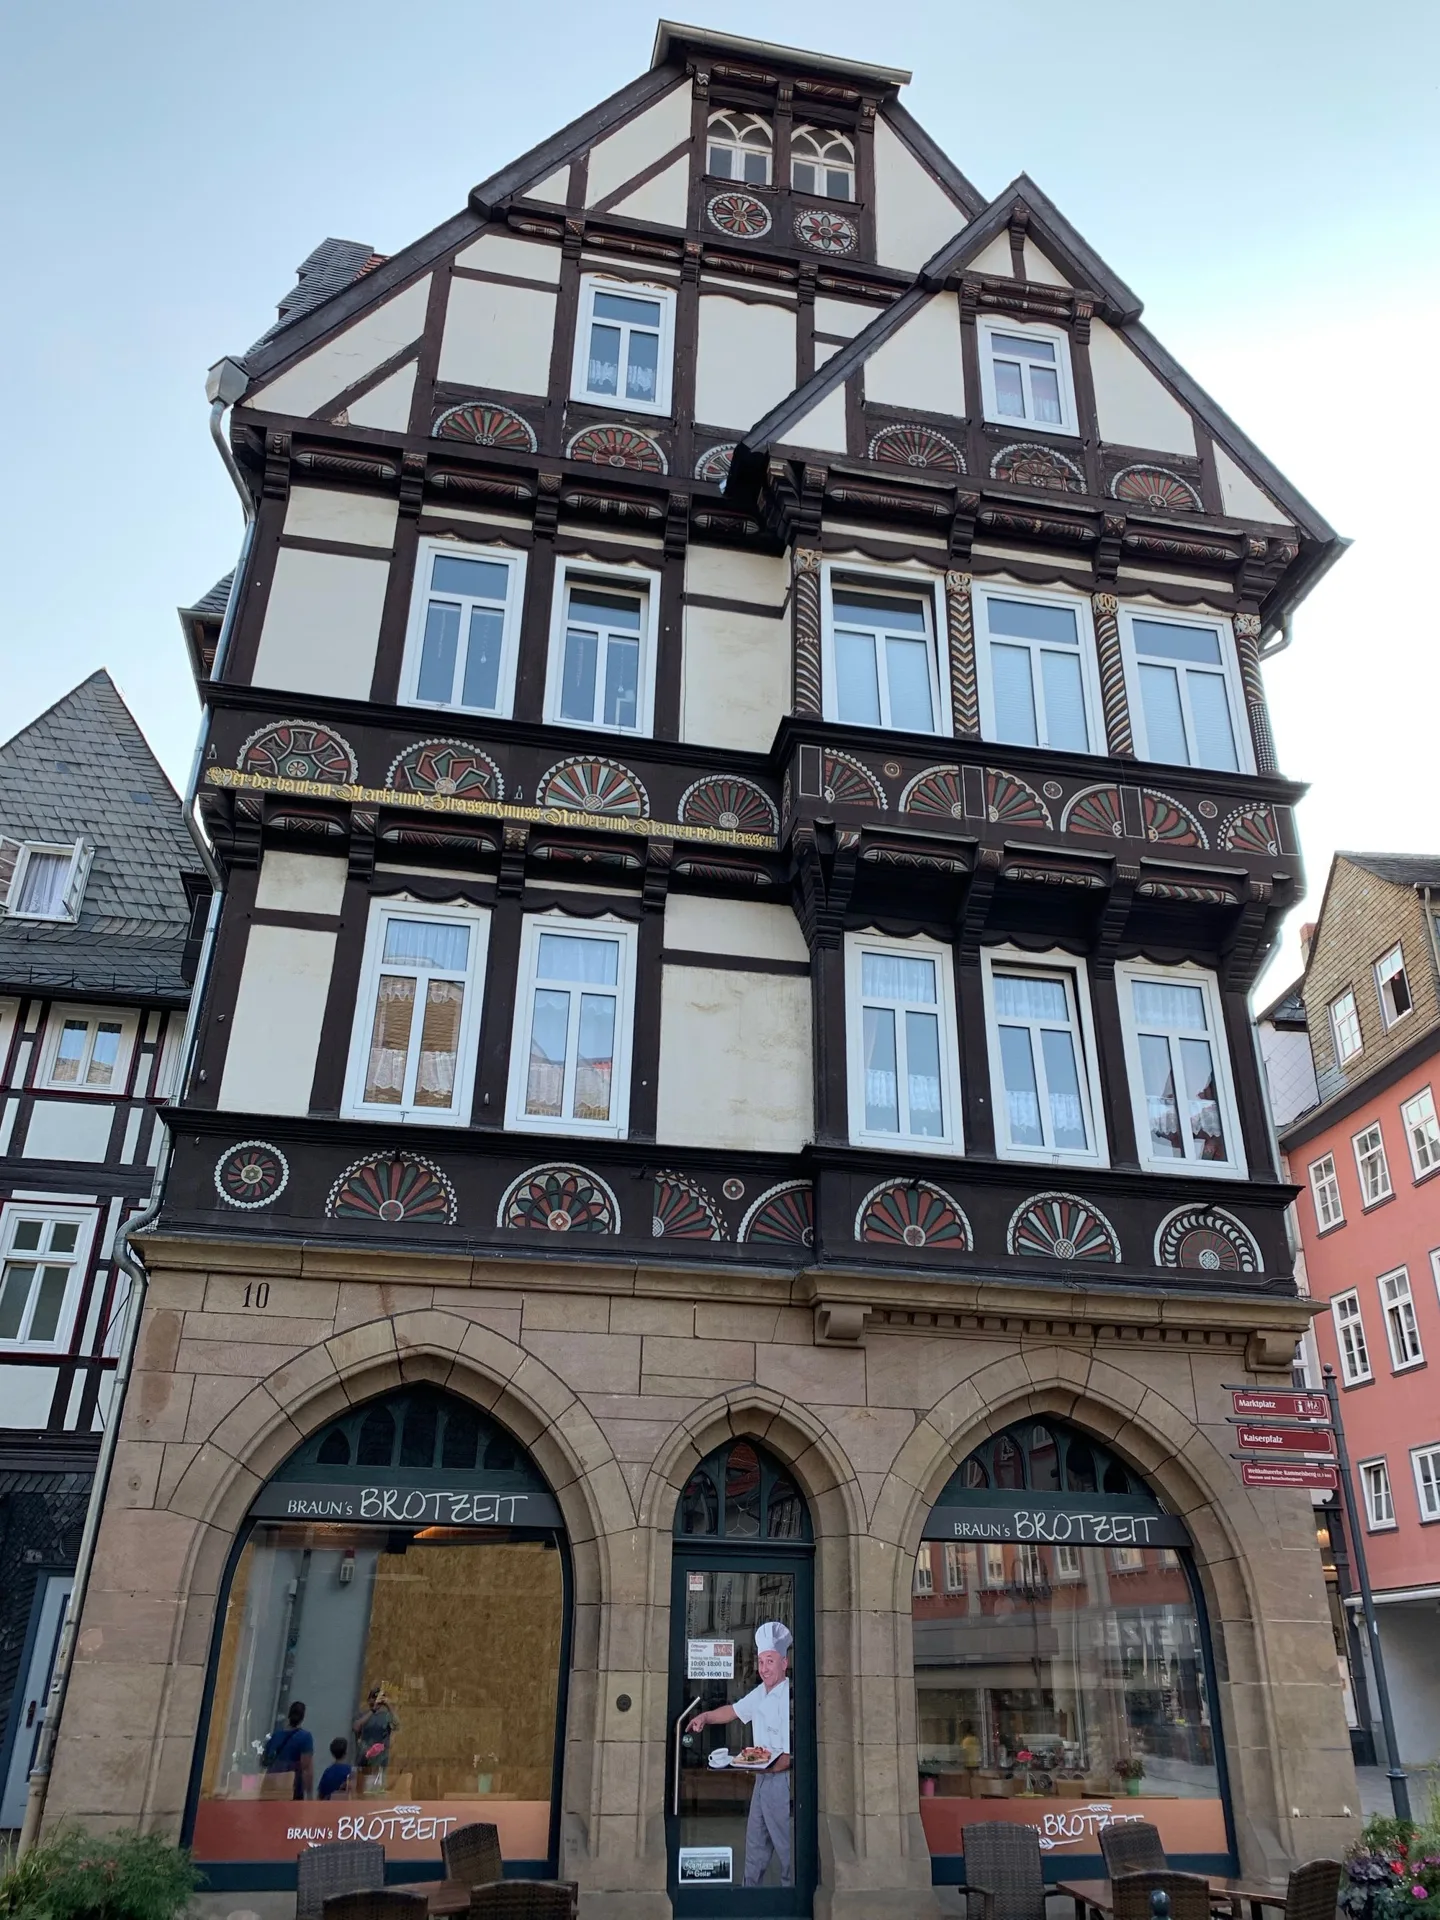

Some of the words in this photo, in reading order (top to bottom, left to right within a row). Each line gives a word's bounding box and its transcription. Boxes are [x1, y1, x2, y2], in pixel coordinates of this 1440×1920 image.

[251, 772, 273, 789] da
[276, 776, 309, 793] baut
[334, 783, 395, 803] Markt
[398, 791, 424, 806] und
[543, 807, 601, 830] Neider
[605, 815, 630, 831] und
[632, 818, 693, 838] Narren
[697, 826, 729, 843] reden
[242, 1282, 270, 1309] 10
[1239, 1399, 1276, 1409] Marktplatz
[1243, 1433, 1283, 1444] Kaiserpfalz
[359, 1488, 529, 1523] BROTZEIT
[1014, 1511, 1159, 1543] BROTZEIT
[337, 1816, 457, 1841] BROTZEIT
[1043, 1813, 1144, 1836] BROTZ
